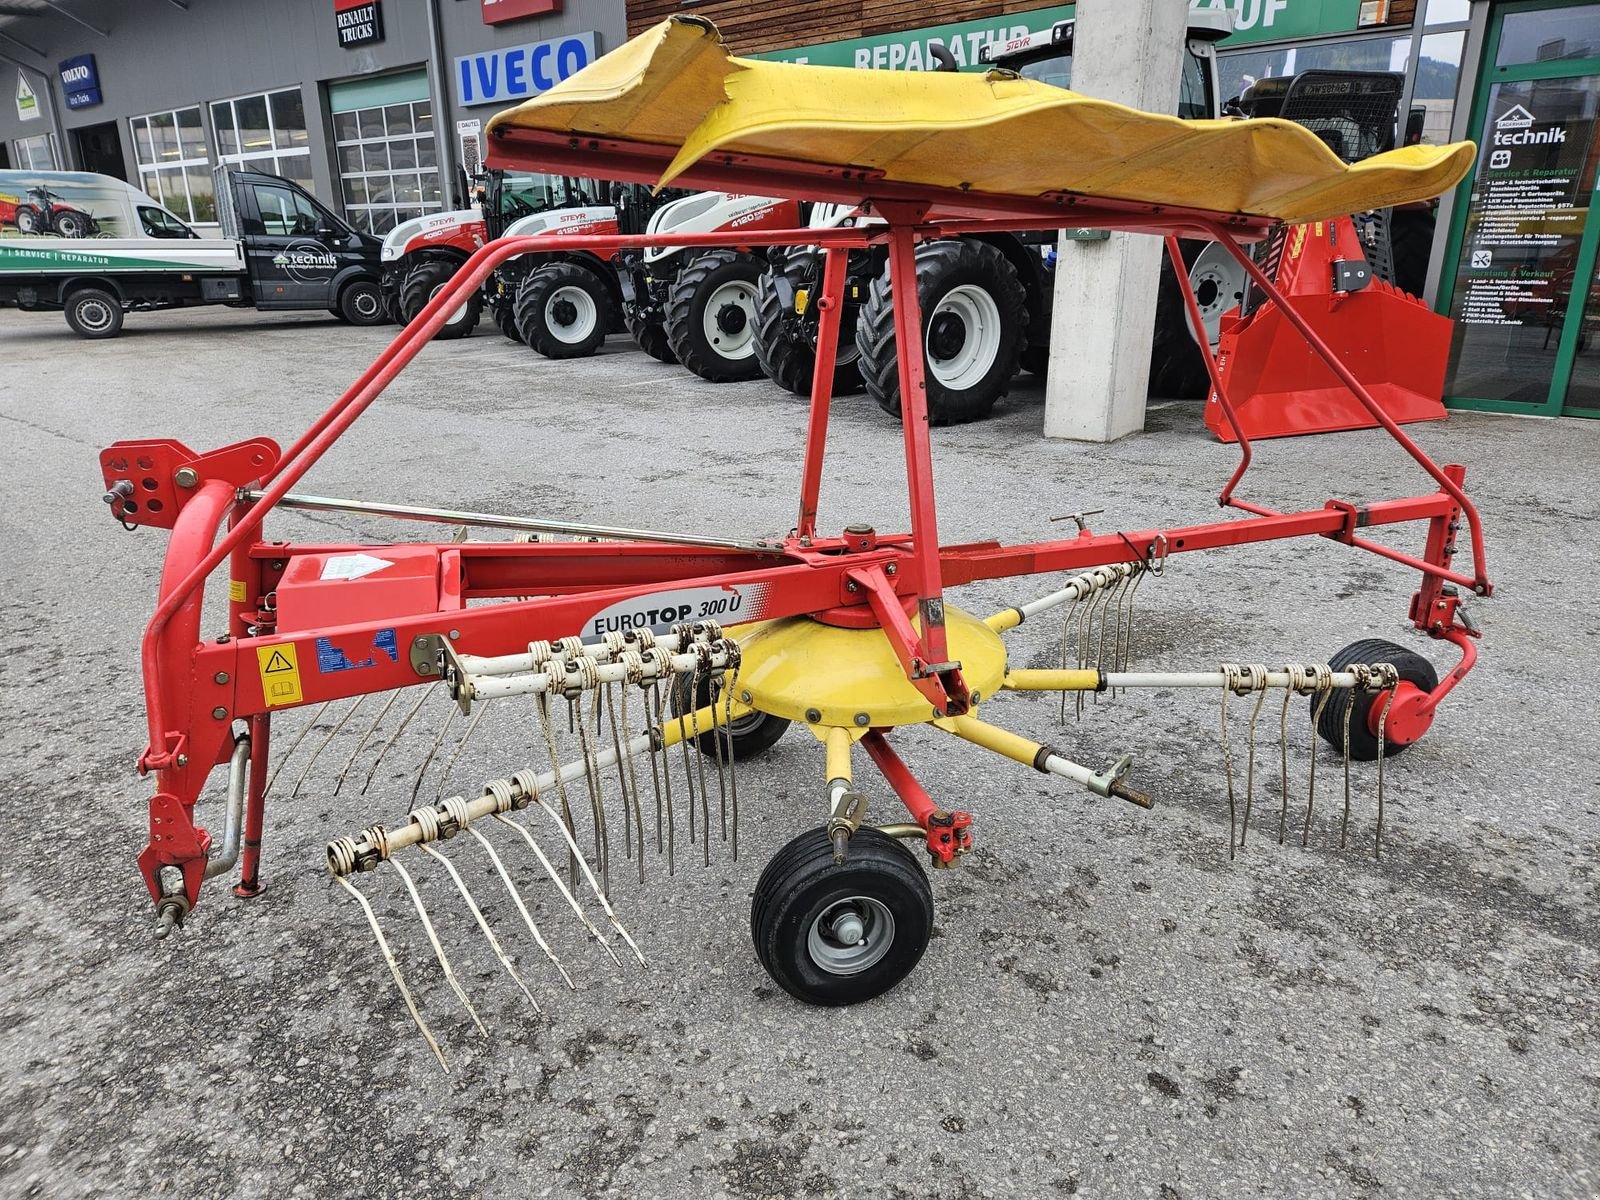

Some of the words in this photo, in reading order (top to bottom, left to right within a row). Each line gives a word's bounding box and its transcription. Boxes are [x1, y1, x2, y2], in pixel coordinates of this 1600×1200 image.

[336, 6, 373, 28] RENAULT
[341, 22, 373, 42] TRUCKS
[1006, 37, 1031, 51] STEYR
[61, 65, 89, 83] VOLVO
[460, 38, 588, 101] IVECO
[1494, 127, 1567, 145] technik
[1488, 169, 1521, 177] Service
[1533, 168, 1578, 177] Reparatur
[560, 213, 587, 222] STEYR
[731, 213, 754, 228] 4120
[15, 250, 50, 259] SERVICE
[61, 253, 109, 264] REPARATUR
[291, 253, 337, 264] technik
[1470, 270, 1508, 278] Beratung
[594, 604, 692, 635] EUROTOP
[698, 598, 728, 618] 300
[729, 595, 743, 612] U
